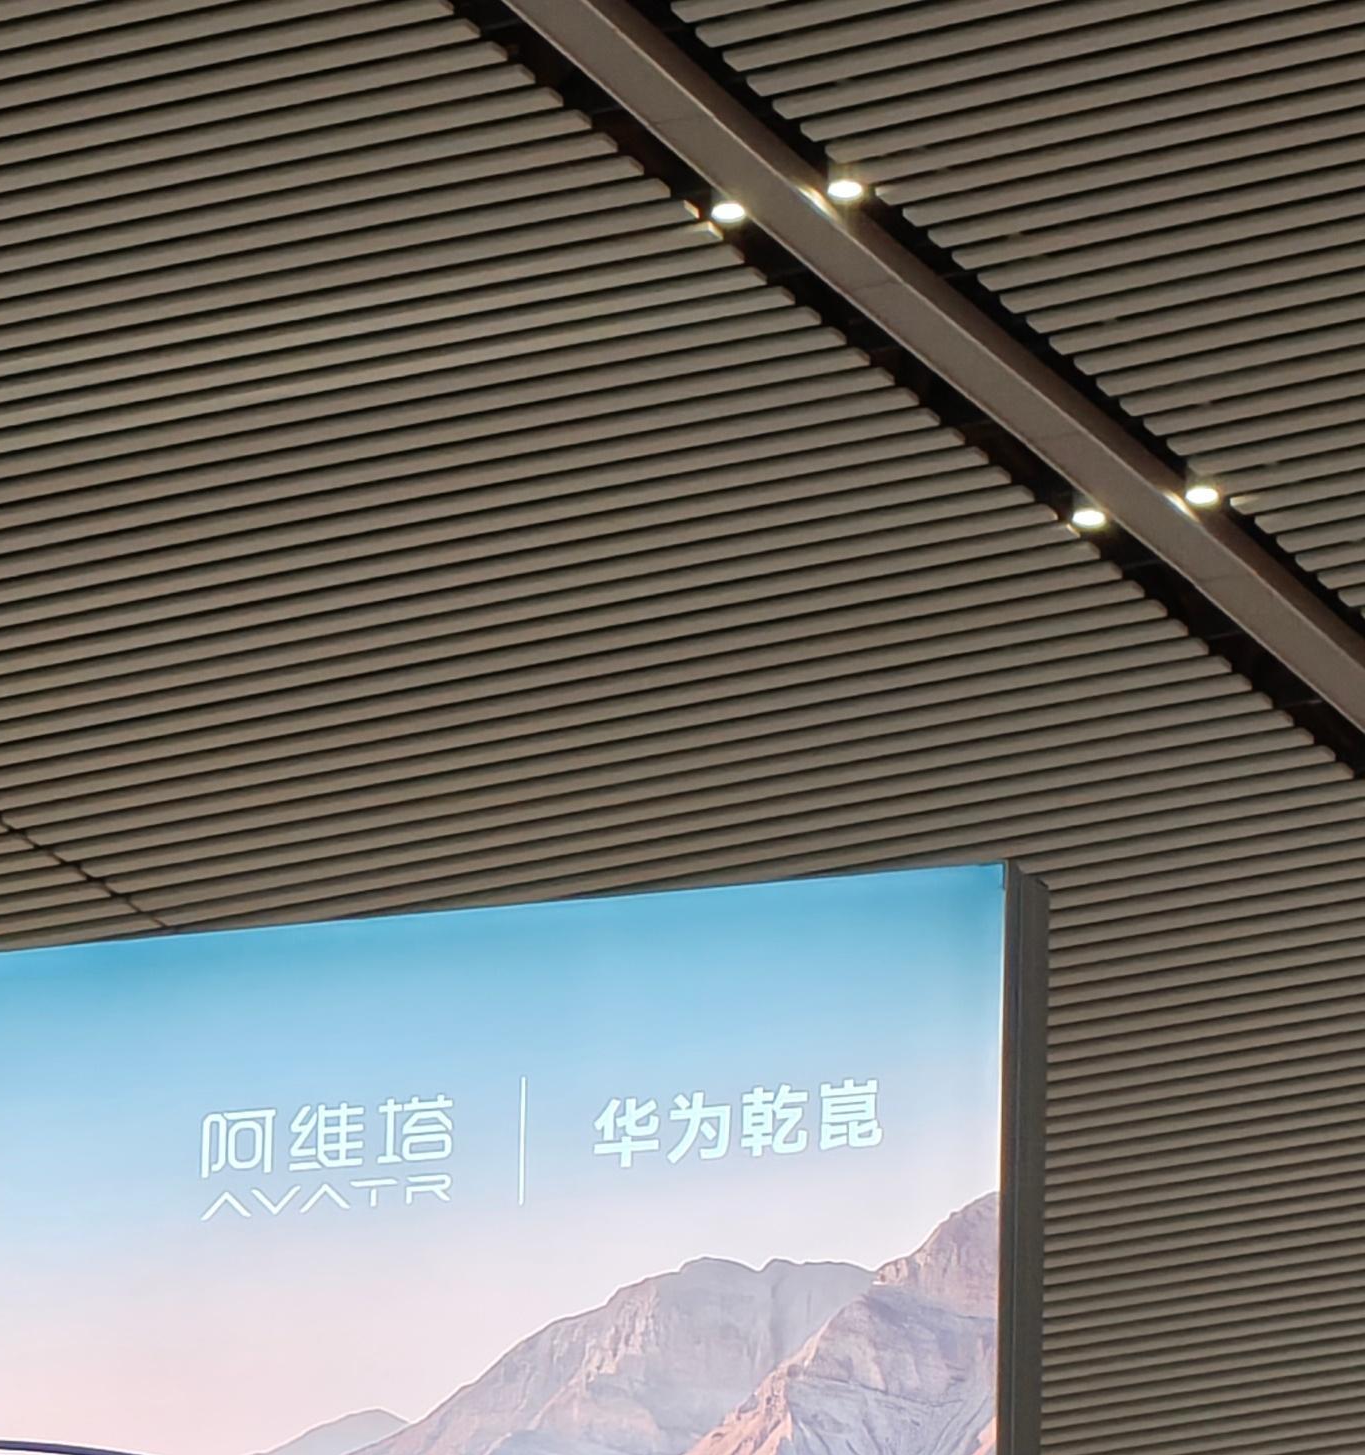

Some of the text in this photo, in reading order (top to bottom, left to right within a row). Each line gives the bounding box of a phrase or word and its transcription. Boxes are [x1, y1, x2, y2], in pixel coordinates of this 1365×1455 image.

[200, 1093, 454, 1179] 阿维塔
[593, 1078, 883, 1169] 华为乾崑
[199, 1174, 453, 1221] AVATR
